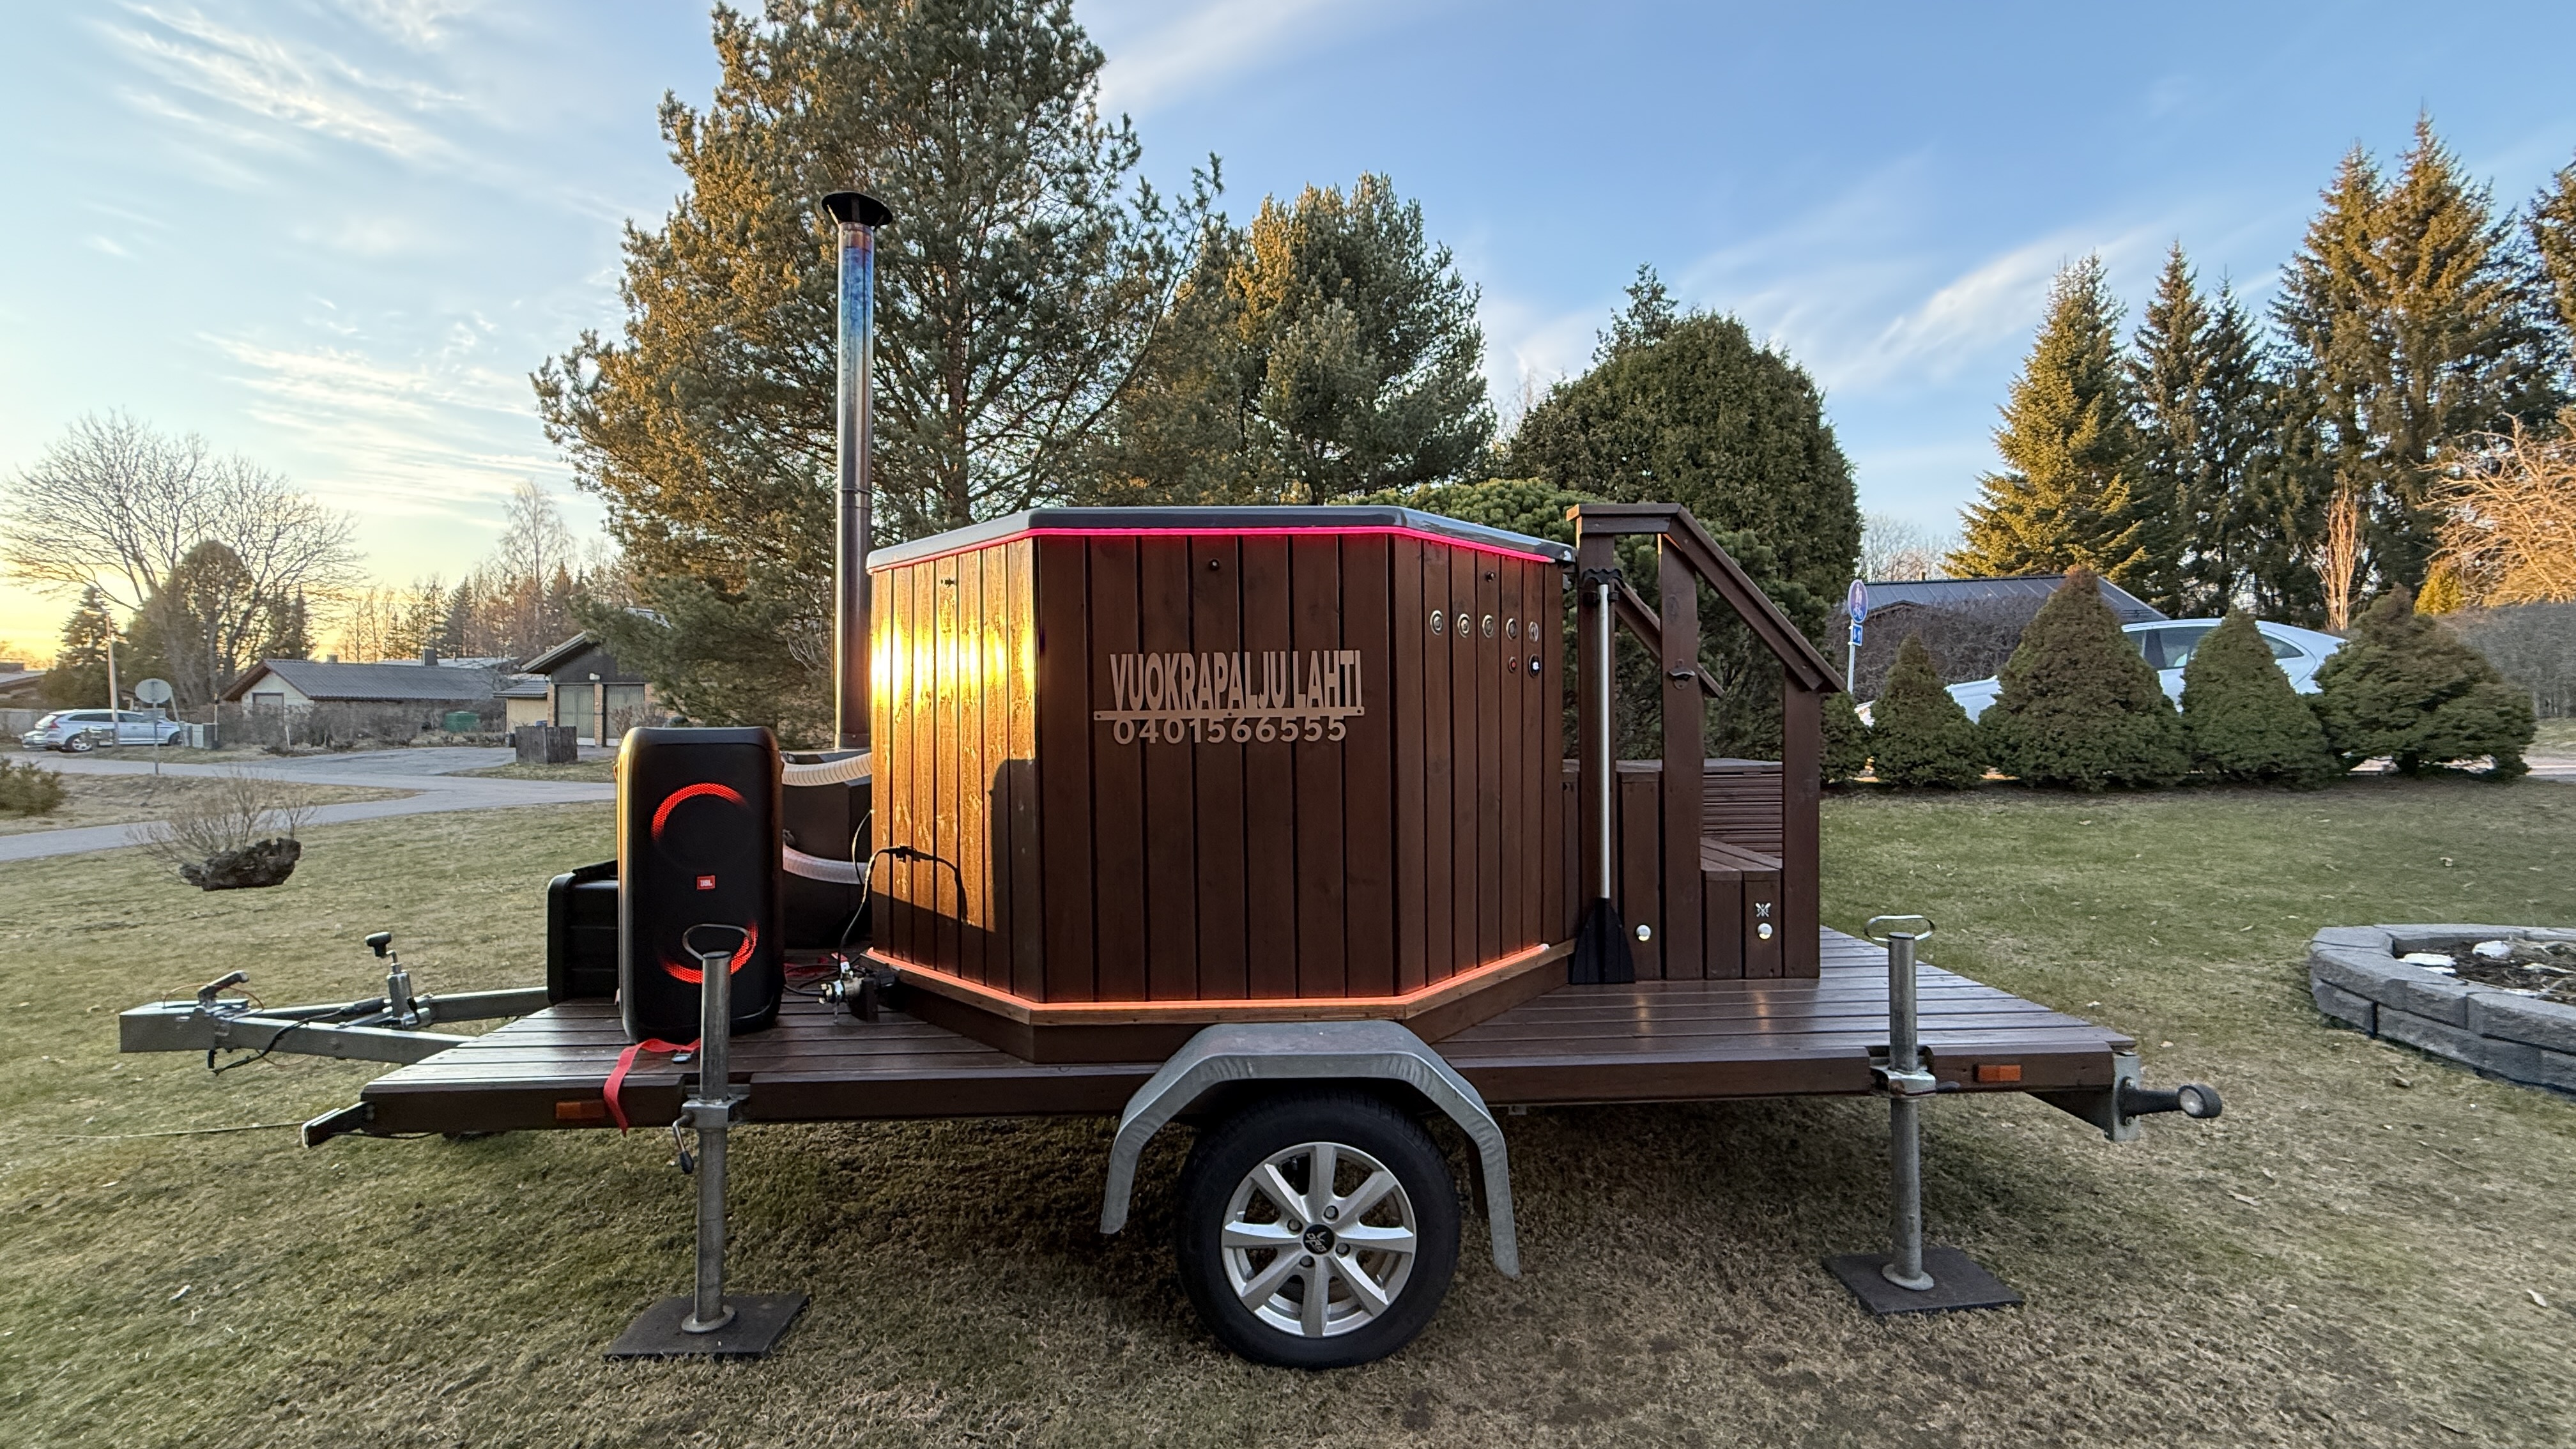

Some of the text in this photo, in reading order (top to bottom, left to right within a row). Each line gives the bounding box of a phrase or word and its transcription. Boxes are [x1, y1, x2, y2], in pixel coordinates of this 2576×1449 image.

[1110, 650, 1362, 710] VUOKRAPALJU LAHTI
[1113, 716, 1347, 744] 0401566555
